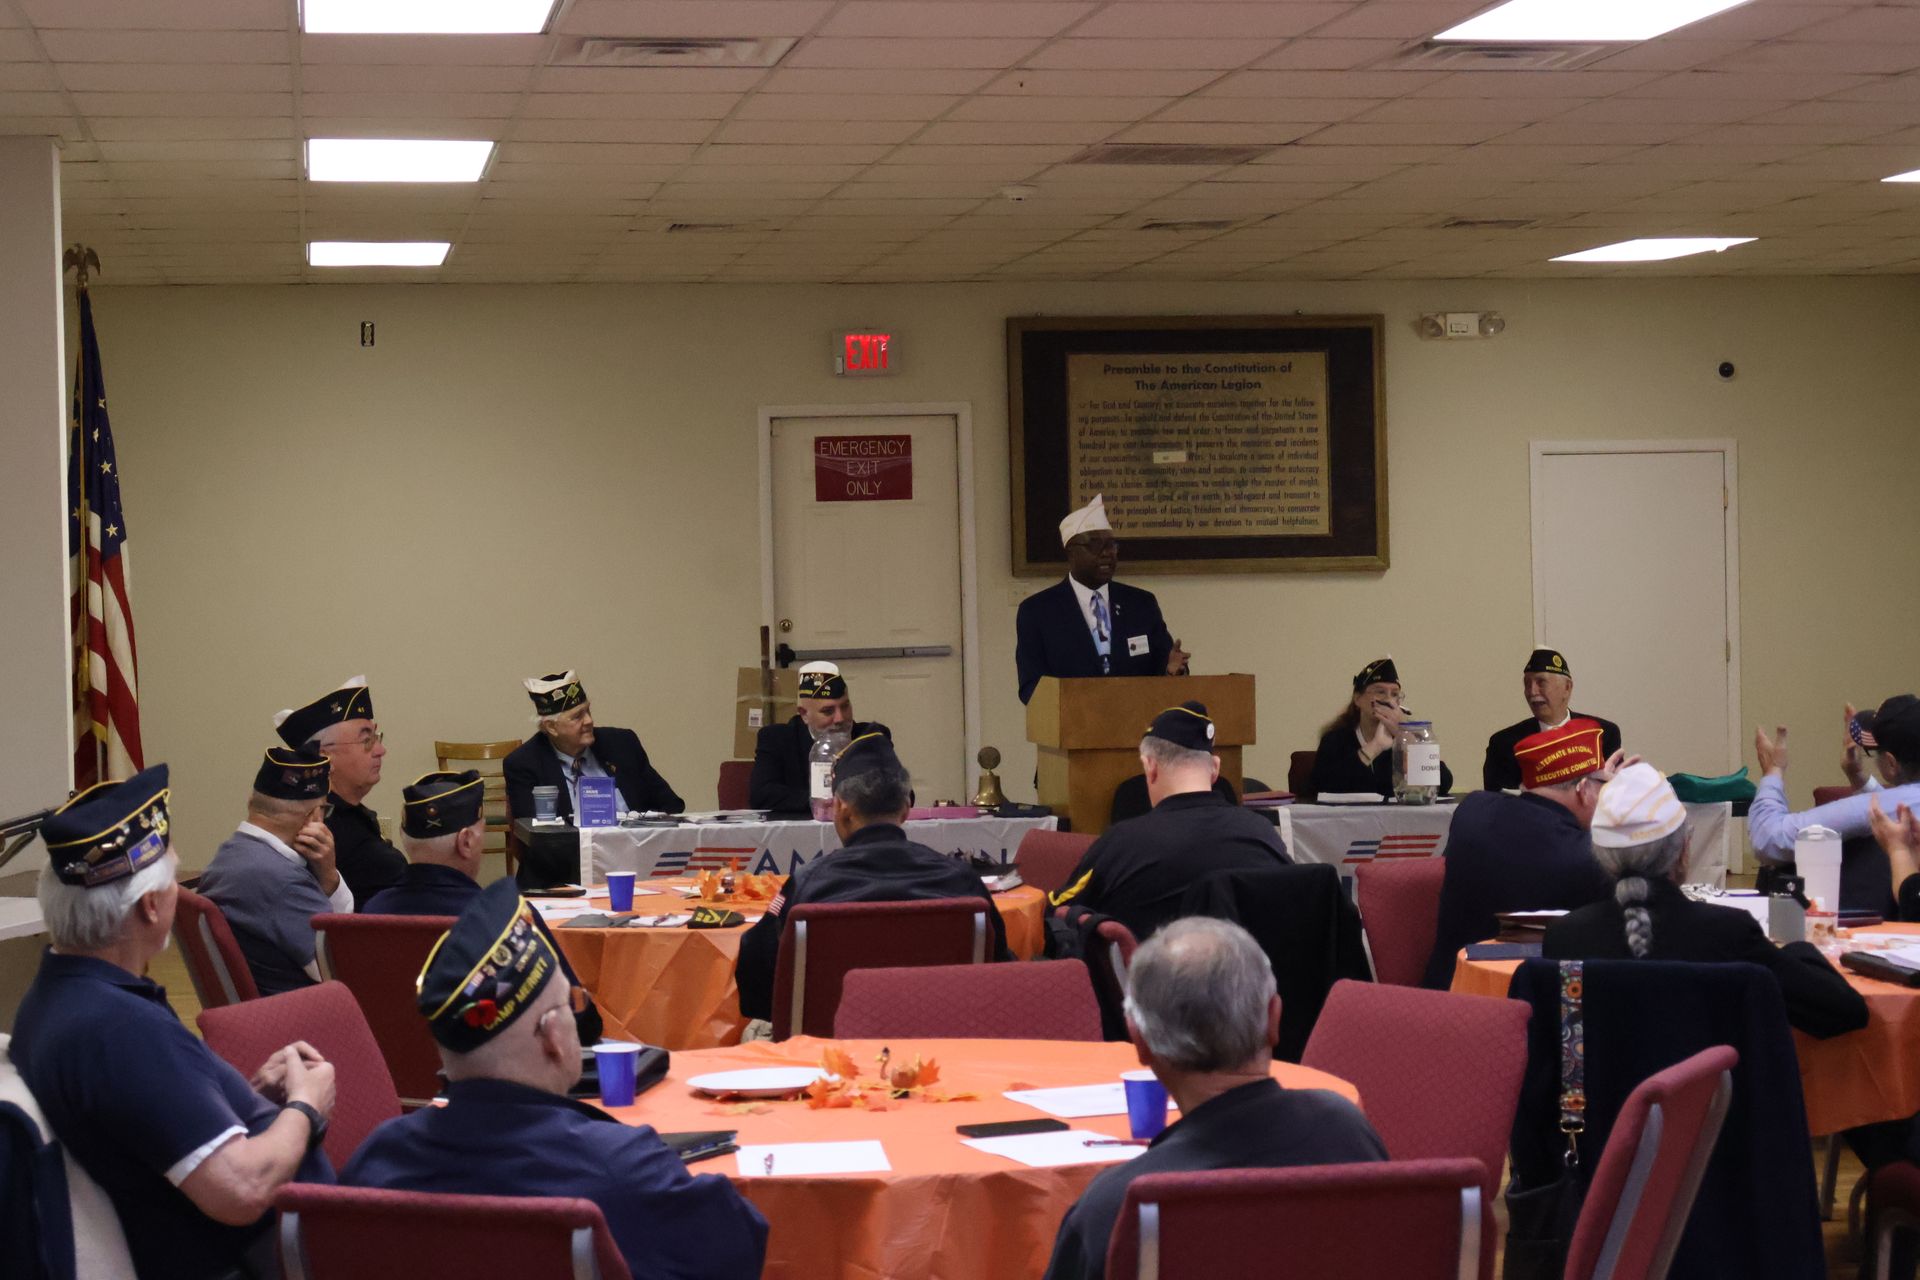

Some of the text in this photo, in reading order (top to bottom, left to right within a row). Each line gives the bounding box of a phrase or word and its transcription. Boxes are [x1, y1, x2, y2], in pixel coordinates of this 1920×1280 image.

[845, 334, 891, 369] EXIT
[1103, 361, 1292, 374] Preamble to the Constitution of
[1135, 379, 1262, 391] The American Legion
[820, 440, 906, 456] EMERGENCY
[846, 460, 880, 476] EXIT
[846, 481, 882, 496] ONLY
[1535, 745, 1593, 772] ALTERNATE NATIONAL
[1535, 768, 1570, 783] EXECUTIVE
